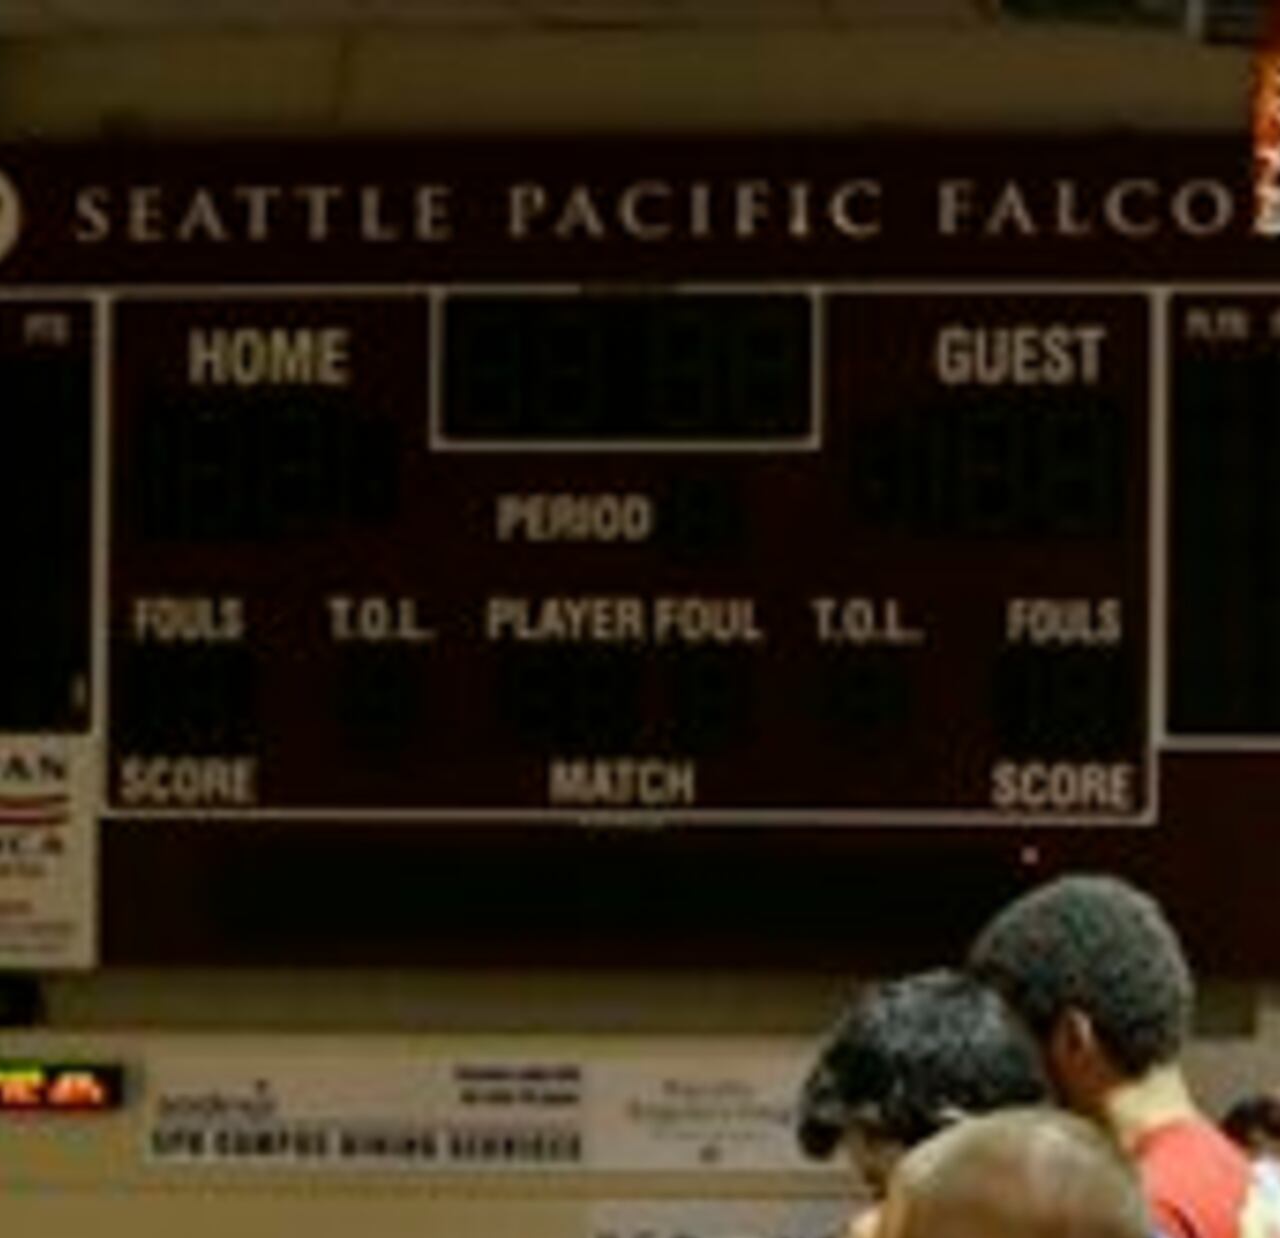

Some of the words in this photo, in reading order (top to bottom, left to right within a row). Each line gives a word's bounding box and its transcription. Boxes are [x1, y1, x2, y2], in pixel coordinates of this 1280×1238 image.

[74, 183, 455, 245] SEATTLE
[505, 178, 885, 240] PACIFIC
[187, 326, 352, 387] HOME
[935, 325, 1108, 387] GUEST
[494, 493, 656, 543] PERIOD
[134, 596, 246, 642] FOULS
[486, 596, 644, 642] PLAYER
[653, 597, 764, 642] FOUL
[1005, 597, 1123, 645] FOULS
[120, 755, 260, 804] SCORE
[548, 757, 696, 805] MATCH
[990, 760, 1136, 810] SCORE
